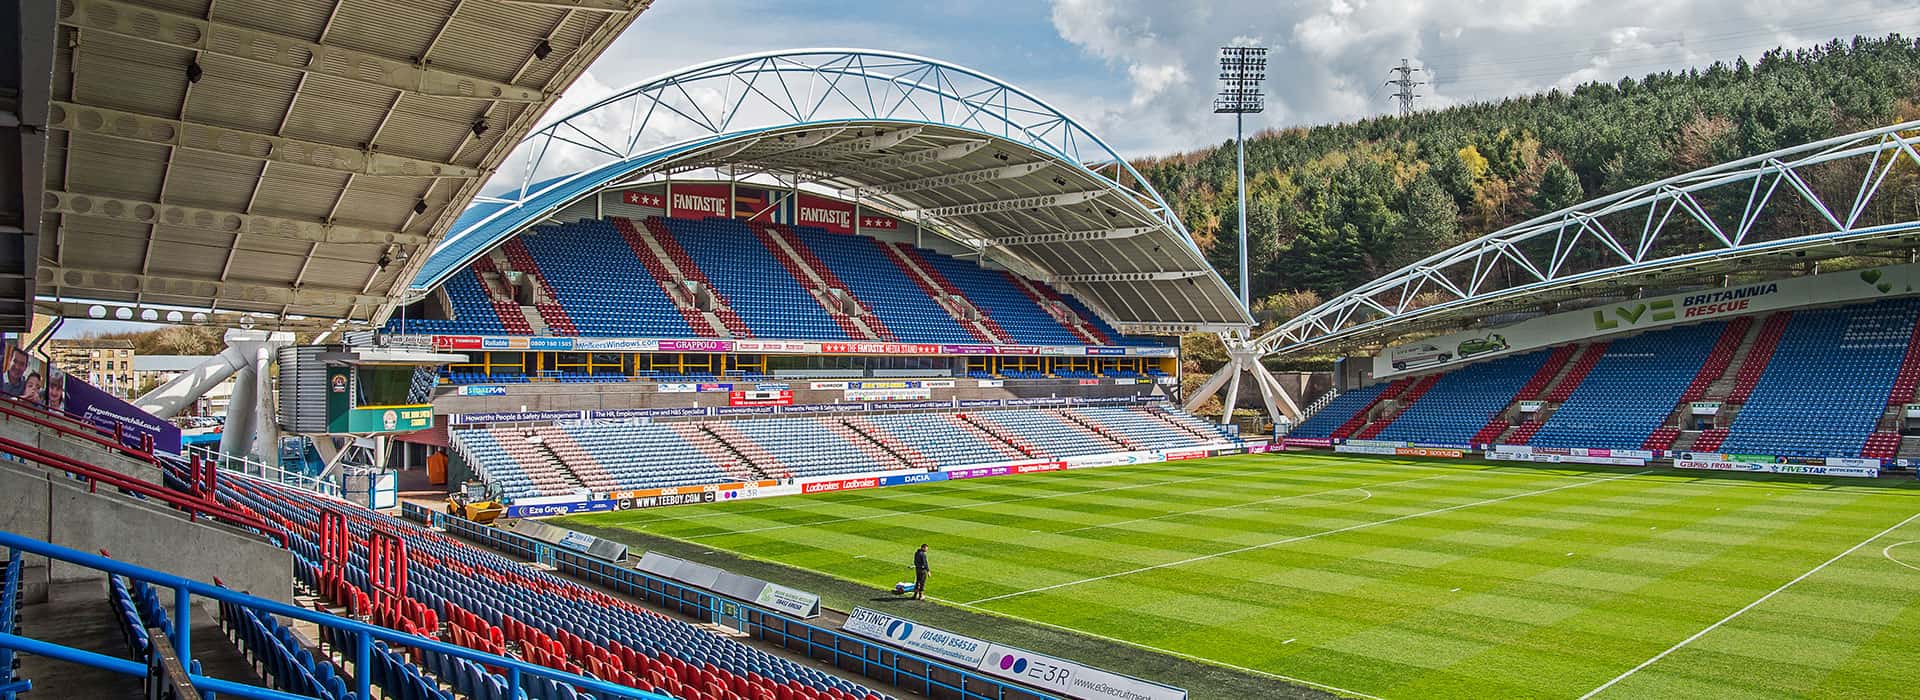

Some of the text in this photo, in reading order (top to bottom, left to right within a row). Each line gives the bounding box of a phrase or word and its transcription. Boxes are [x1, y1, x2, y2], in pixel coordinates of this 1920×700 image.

[674, 193, 726, 213] FANTASTIC
[800, 207, 850, 225] FANTASTIC
[1683, 283, 1778, 307] BRITANNIA
[1685, 300, 1751, 318] RESCUE
[675, 341, 717, 349] GRAPPOLO
[847, 344, 918, 353] THE FANTASTIC MEDIA STAND
[87, 404, 161, 433] forgetmenotchild.co.uk
[495, 414, 516, 422] People
[540, 412, 579, 420] Management
[806, 479, 875, 492] Ladbrokes Ladbrokes
[904, 474, 930, 482] DACIA
[636, 493, 701, 508] WWW.TEEBOY.COM
[544, 505, 569, 514] Group
[851, 608, 892, 627] DISTINCT
[1028, 661, 1070, 686] E3R
